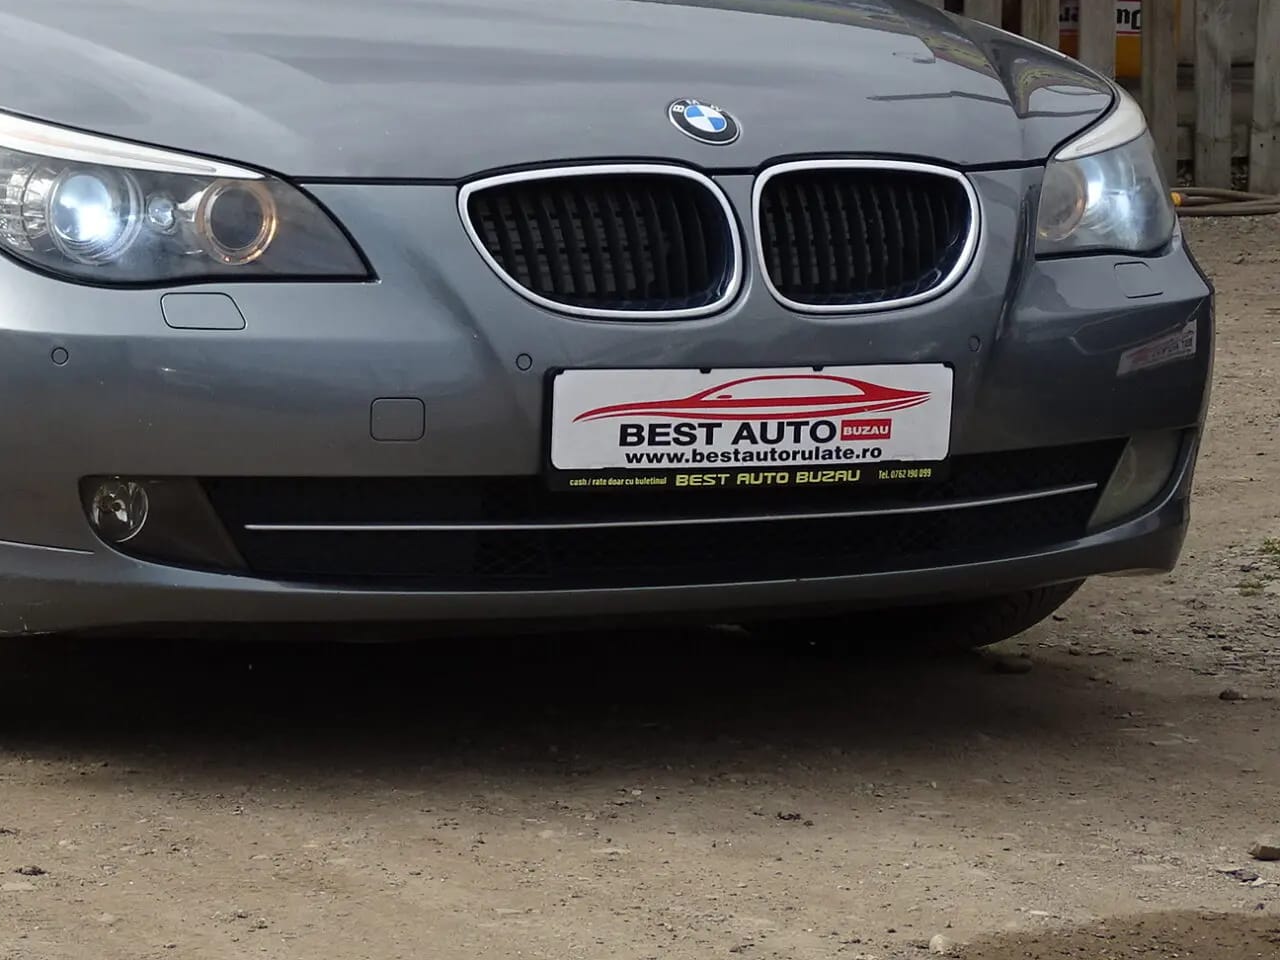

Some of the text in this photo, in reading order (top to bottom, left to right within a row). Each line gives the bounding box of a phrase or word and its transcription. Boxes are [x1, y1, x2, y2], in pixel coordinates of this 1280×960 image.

[619, 420, 889, 447] BEST AUTO BUZAU
[625, 445, 882, 464] www.bestautorulate.ro
[675, 473, 730, 486] BEST
[737, 472, 789, 485] AUTO
[796, 469, 860, 483] BUZAU
